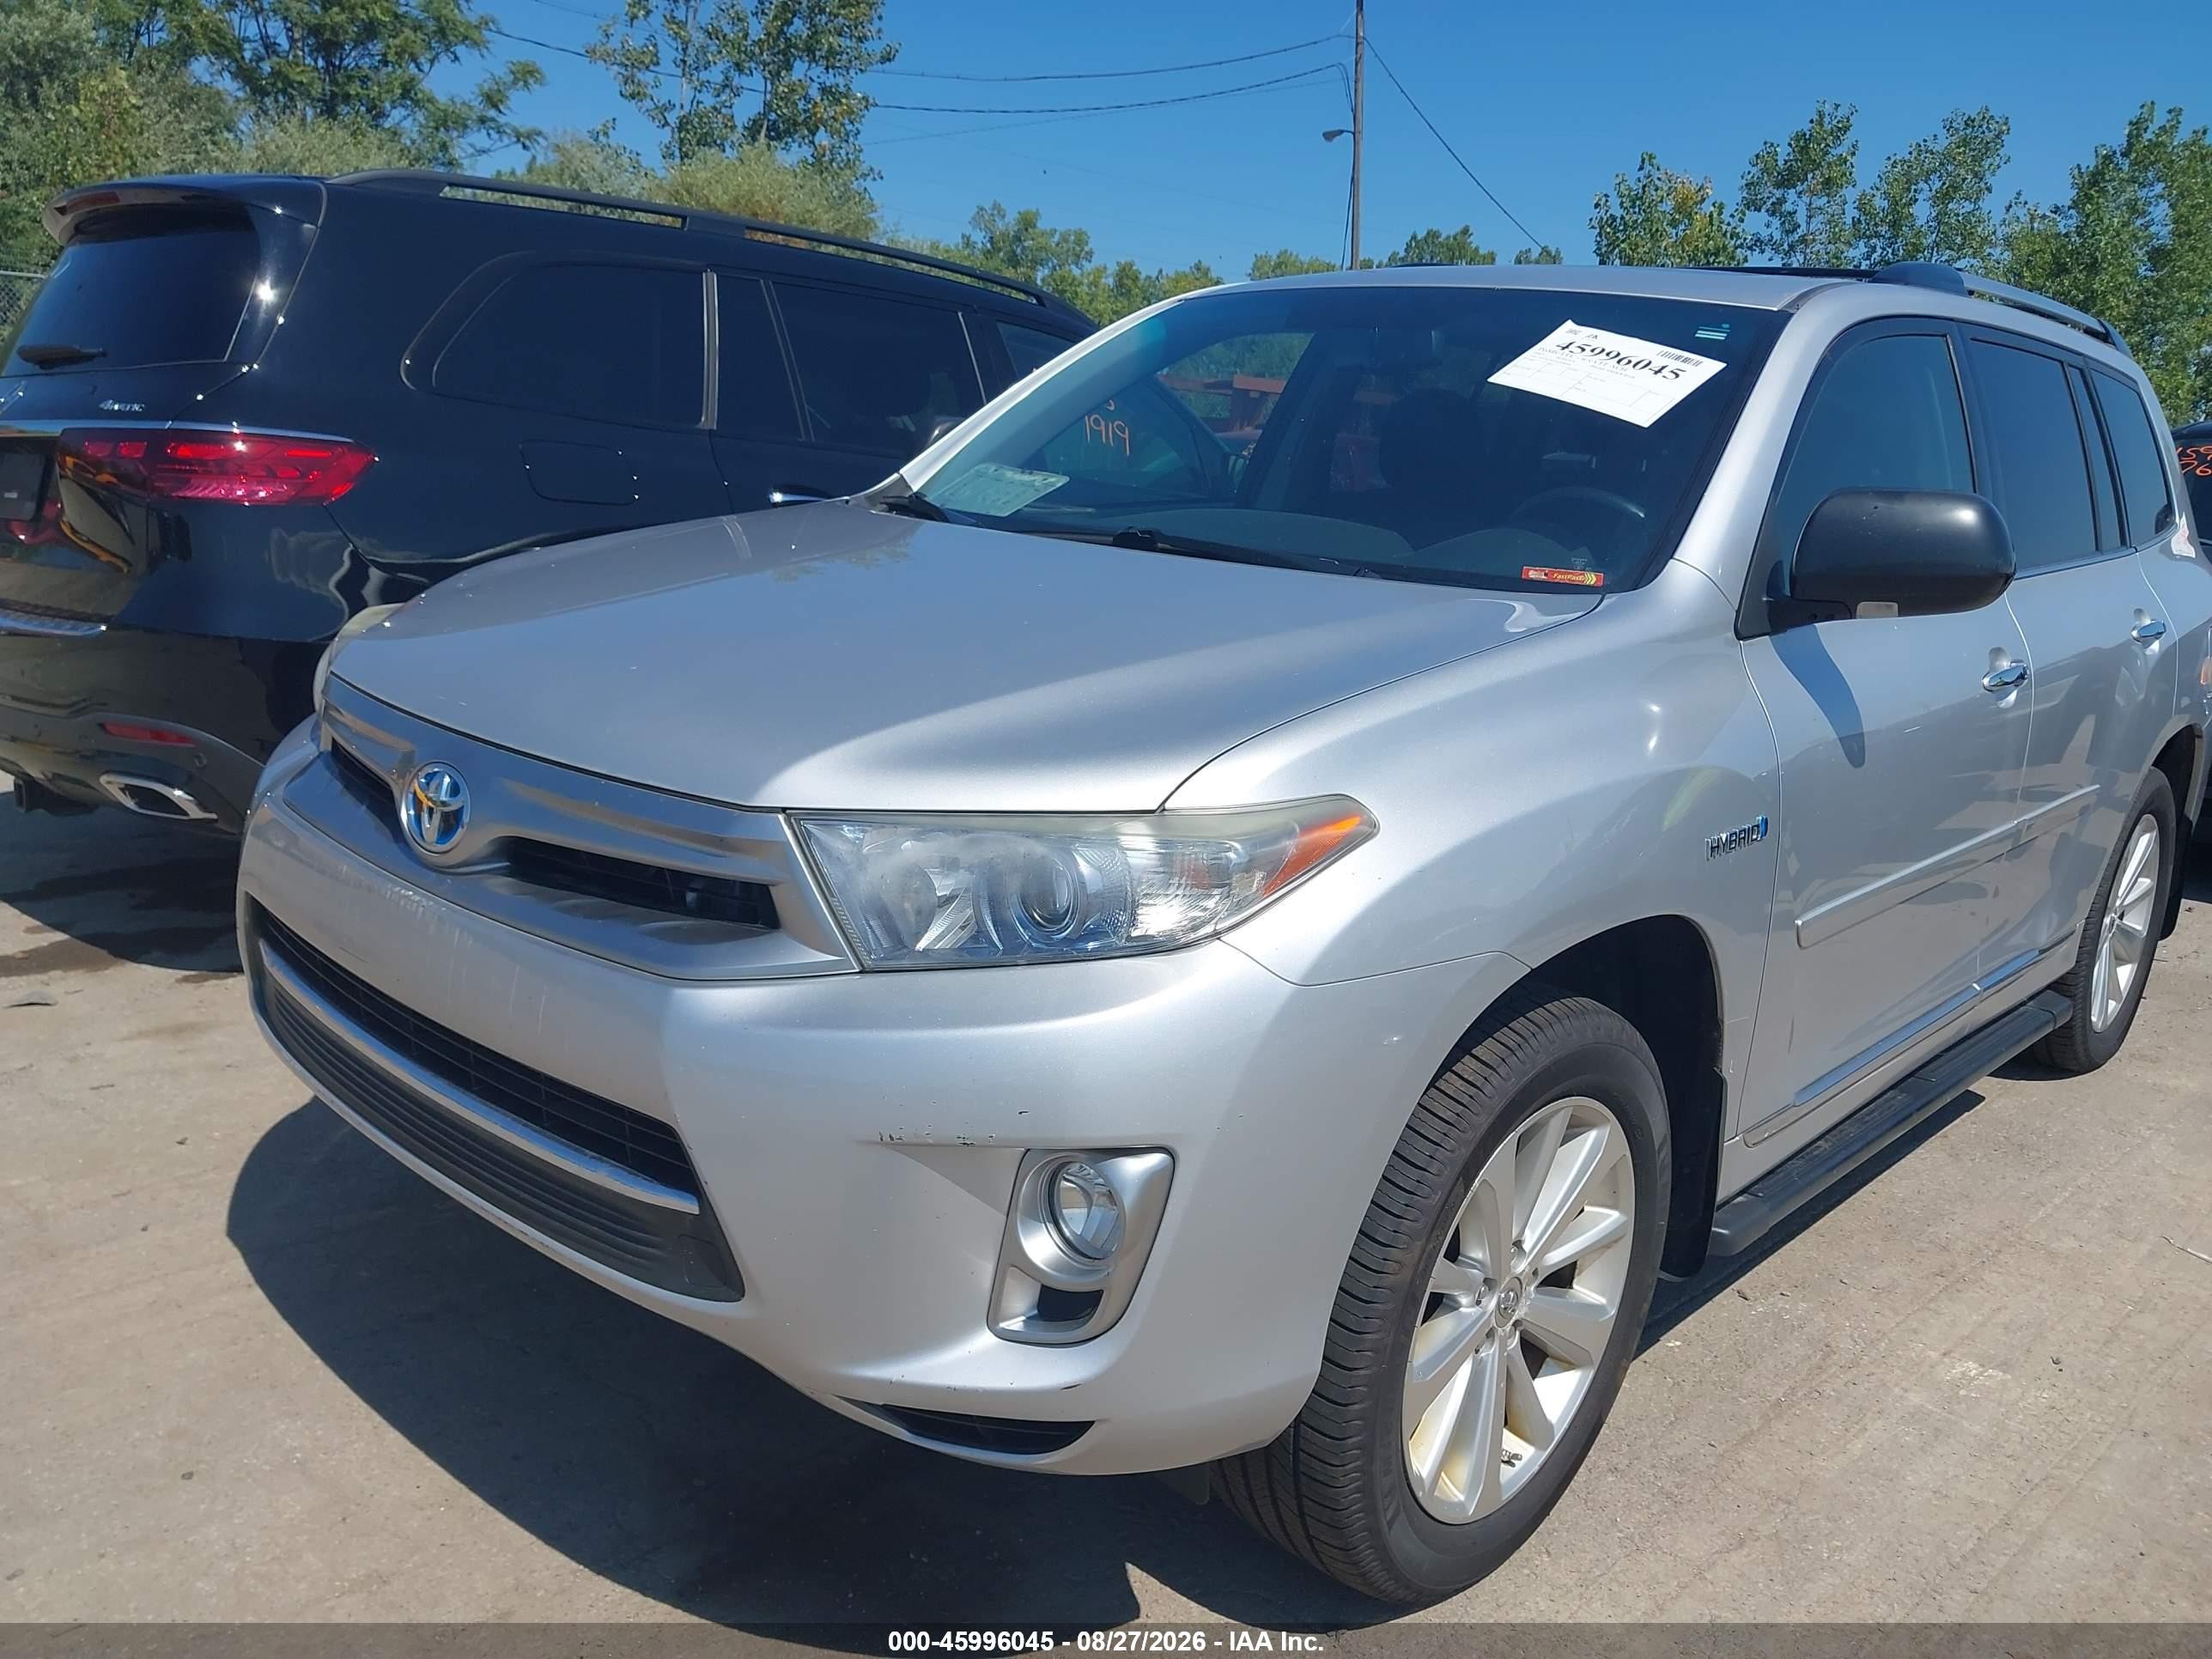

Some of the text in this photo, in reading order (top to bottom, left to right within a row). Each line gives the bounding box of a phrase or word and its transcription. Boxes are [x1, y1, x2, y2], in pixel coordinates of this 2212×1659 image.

[1555, 340, 1686, 380] 45996045
[1085, 414, 1130, 457] 1919
[1705, 823, 1760, 860] HYBRID
